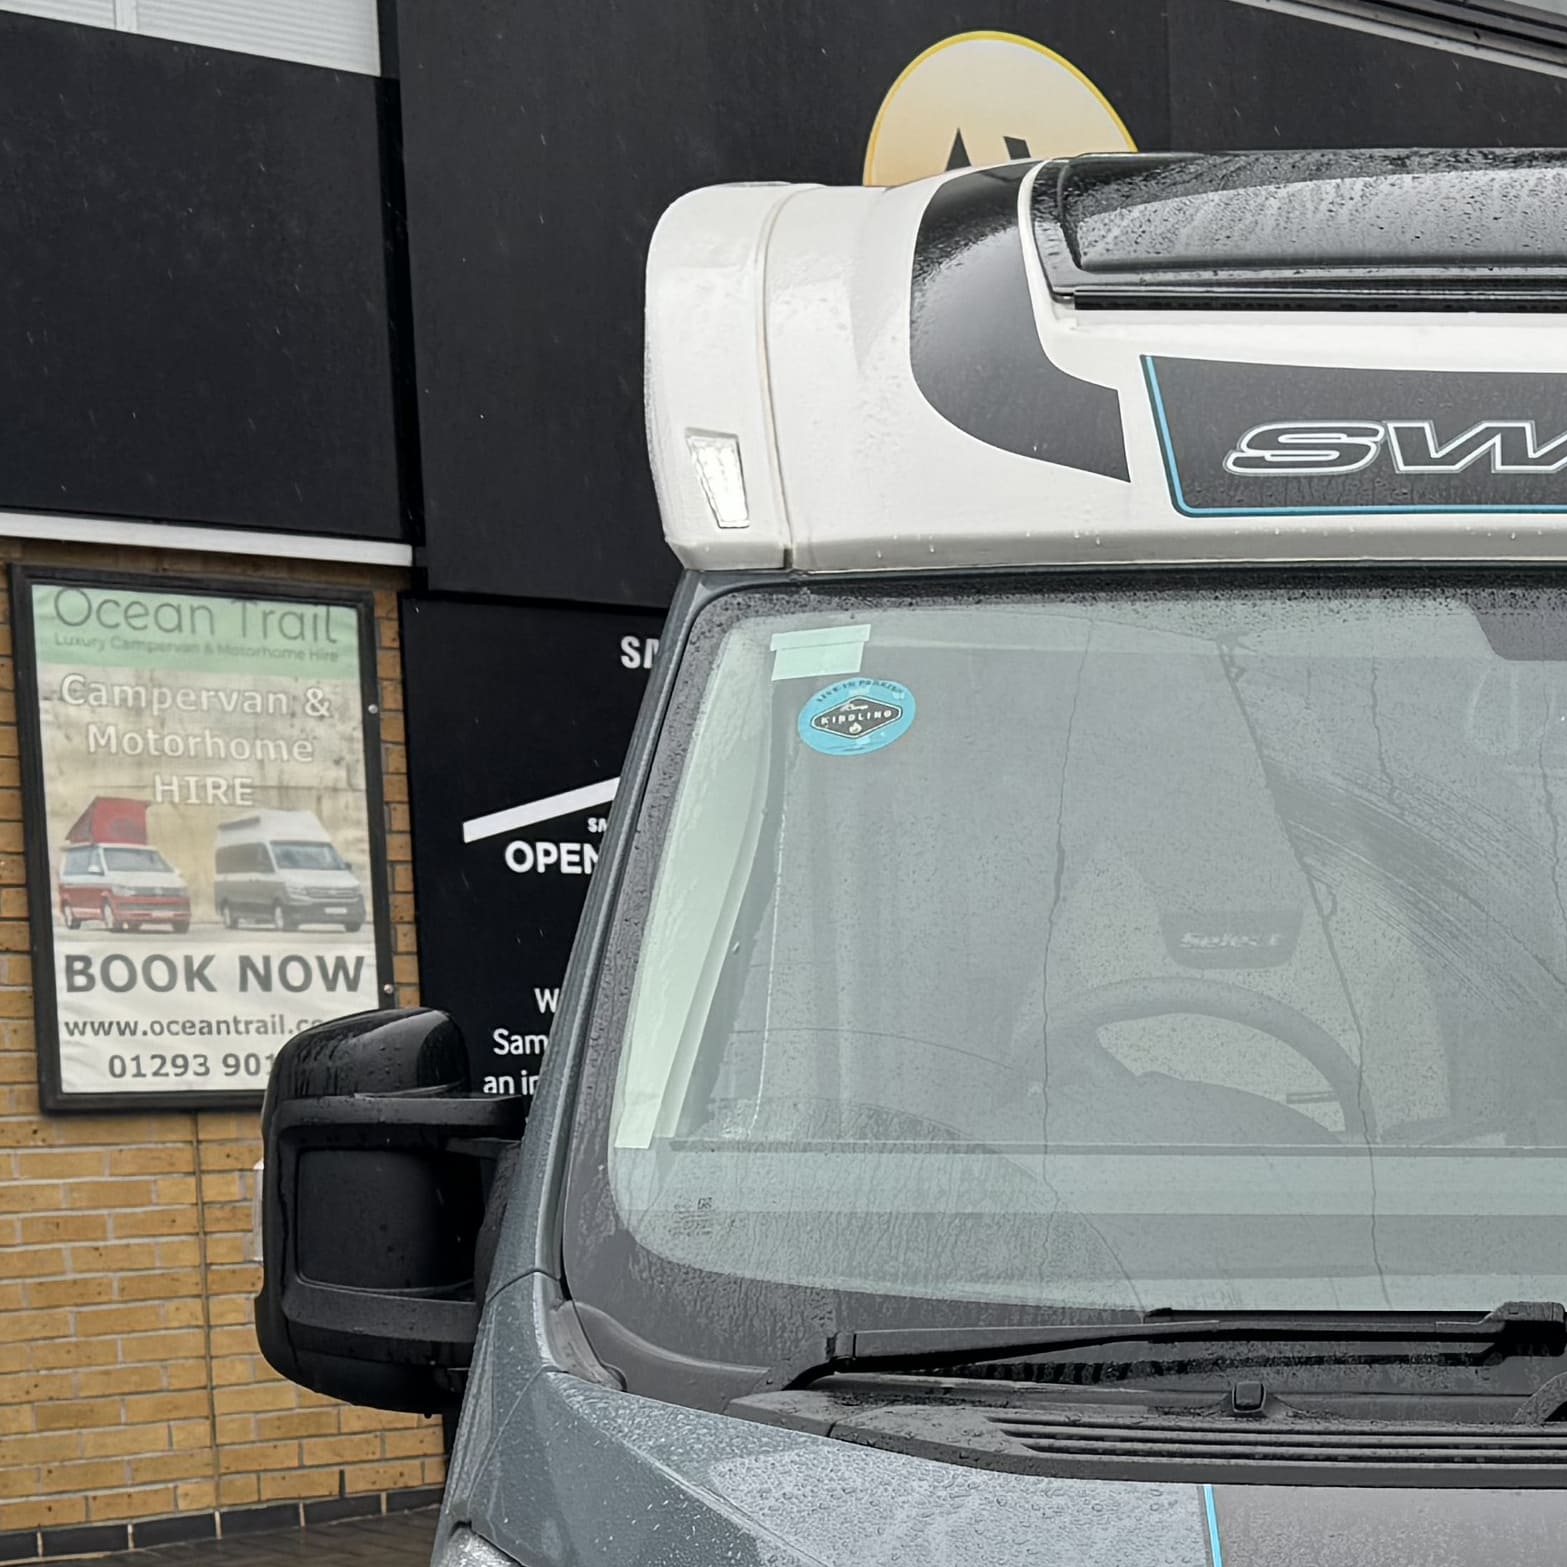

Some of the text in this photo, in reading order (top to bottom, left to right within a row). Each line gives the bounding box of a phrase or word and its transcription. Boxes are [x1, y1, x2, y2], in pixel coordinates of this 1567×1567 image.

[54, 586, 337, 644] Ocean Trail
[60, 673, 334, 718] Campervan &
[87, 723, 314, 763] Motorhome
[153, 774, 255, 806] HIRE
[64, 954, 366, 994] BOOK NOW
[108, 1053, 211, 1079] 01293
[483, 1075, 515, 1095] an
